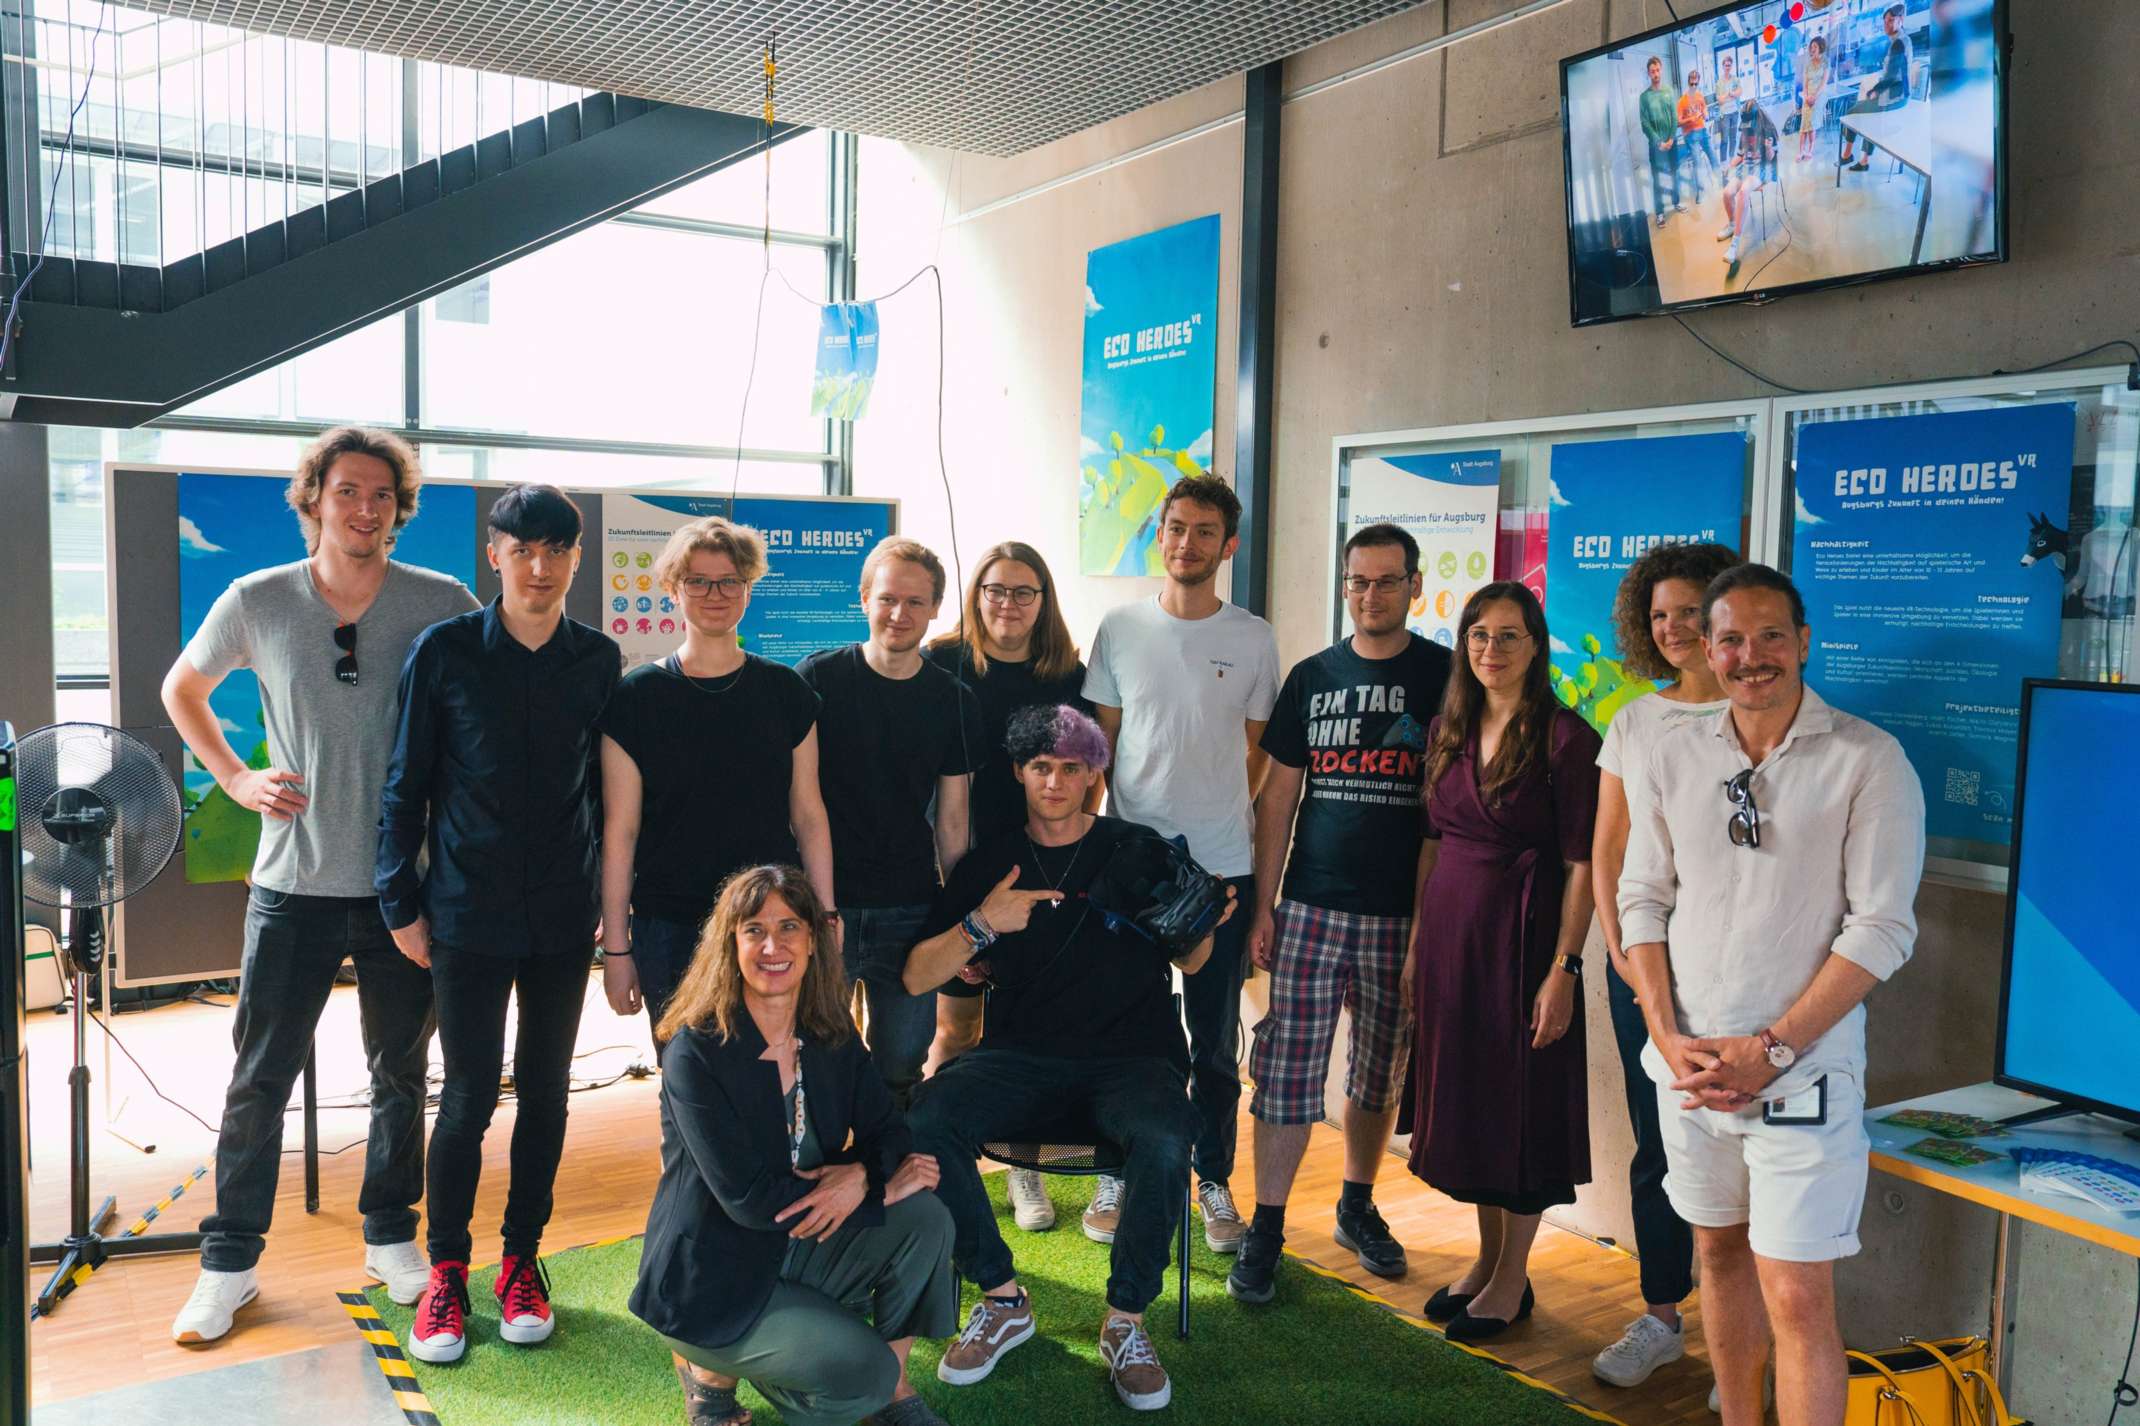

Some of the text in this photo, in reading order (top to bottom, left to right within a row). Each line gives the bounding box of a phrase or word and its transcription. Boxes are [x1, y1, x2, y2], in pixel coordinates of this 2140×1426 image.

[1103, 313, 1201, 359] ECO HEROES VR
[1834, 453, 2037, 496] ECO HEROES VR
[1923, 499, 1933, 507] in
[1354, 511, 1486, 525] Zukunftsleitlinien für Augsburg
[608, 528, 672, 537] Zukunftsleitlinien
[759, 528, 873, 548] ECO HEROES VR
[1573, 535, 1612, 558] ECO
[1701, 529, 1715, 541] VR
[1309, 685, 1406, 720] EIN TAG
[1307, 718, 1362, 747] OHNE
[1310, 750, 1418, 777] ZOCKEN
